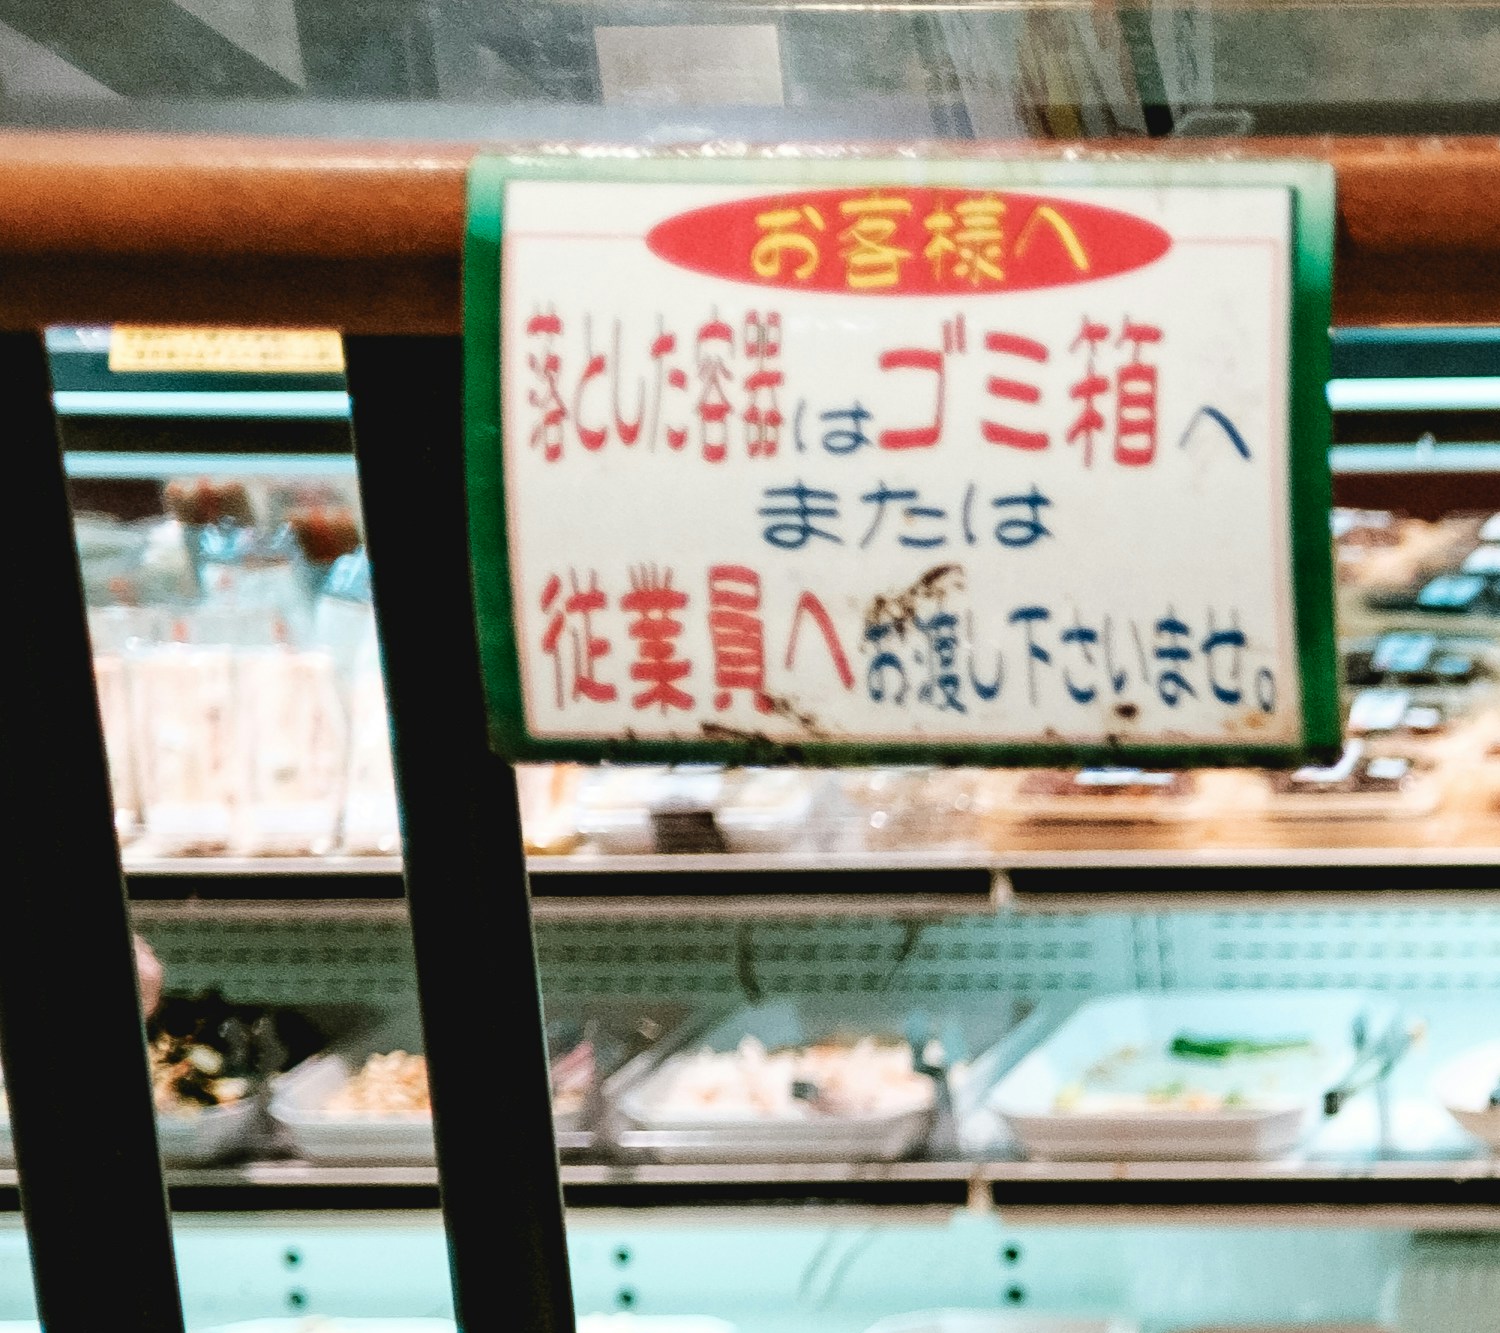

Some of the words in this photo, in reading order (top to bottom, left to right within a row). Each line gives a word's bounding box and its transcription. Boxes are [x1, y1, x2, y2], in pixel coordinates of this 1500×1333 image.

[751, 195, 1091, 289] お客様へ
[526, 306, 1253, 468] 落とした容器はゴミ箱へ
[758, 482, 1053, 551] または
[540, 563, 1277, 717] 従業員へお渡し下さいませ。
